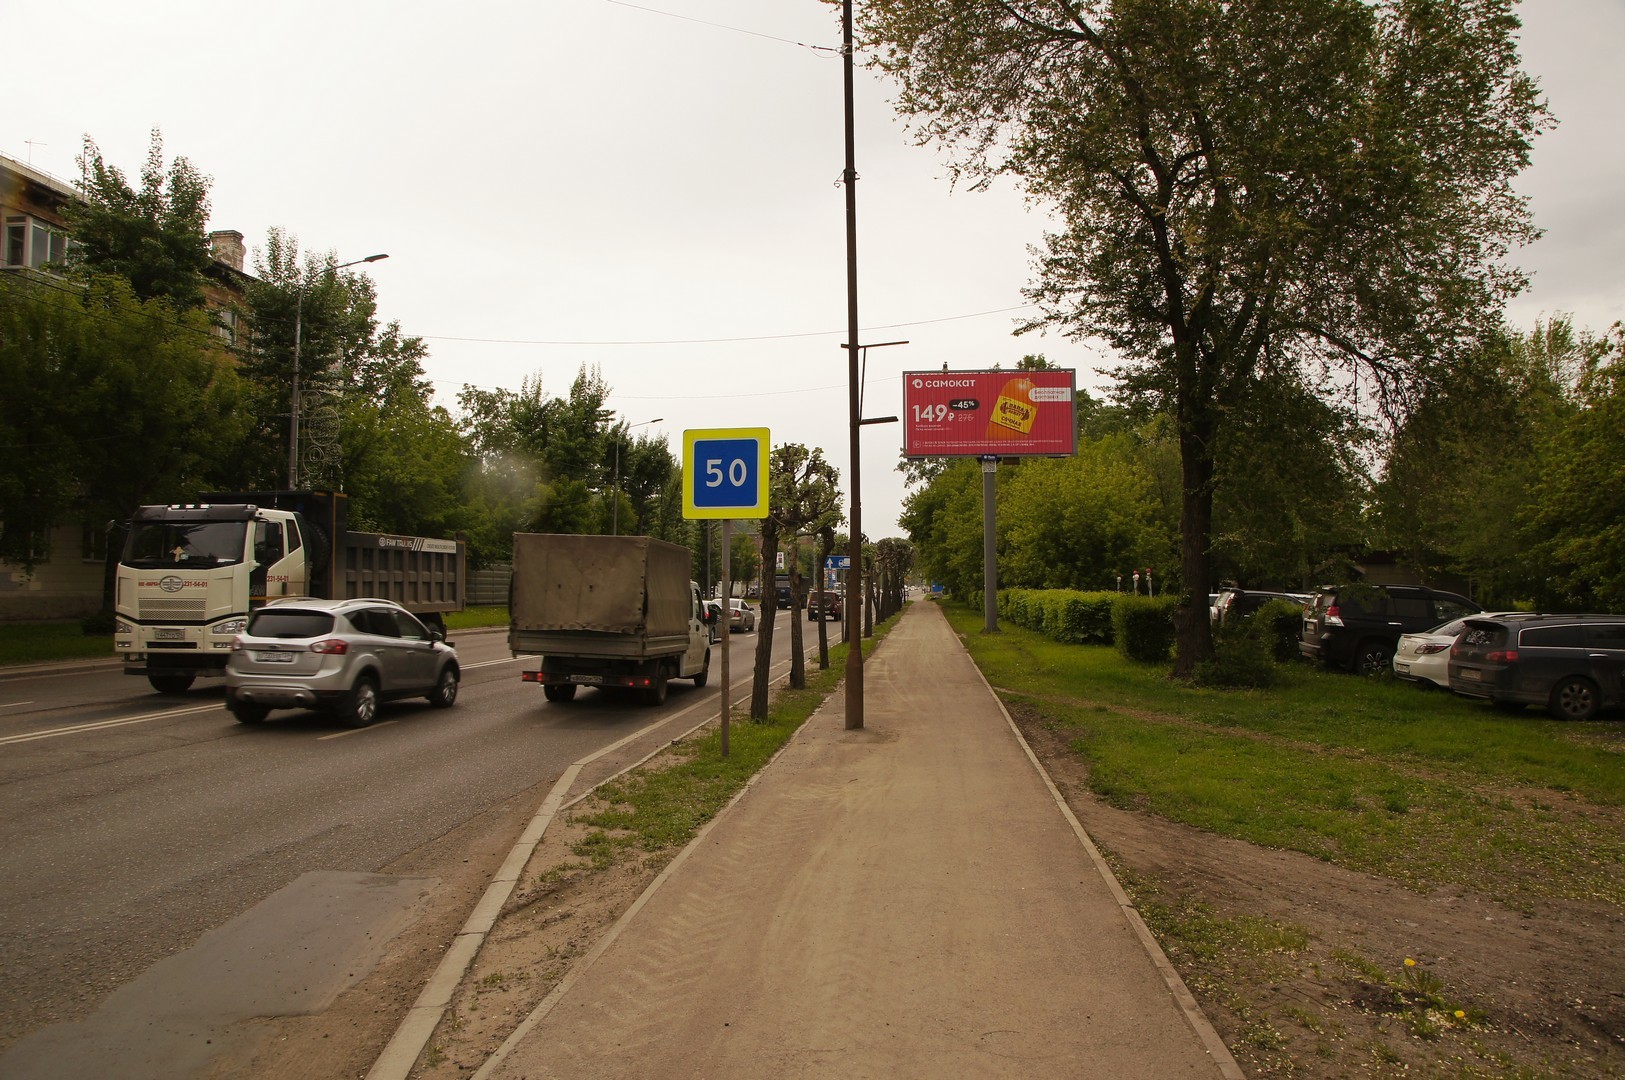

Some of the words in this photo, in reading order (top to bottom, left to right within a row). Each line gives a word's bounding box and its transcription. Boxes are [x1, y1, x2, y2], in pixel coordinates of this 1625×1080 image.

[925, 379, 976, 388] самокат
[706, 458, 747, 488] 50
[183, 580, 208, 588] 231-54-01
